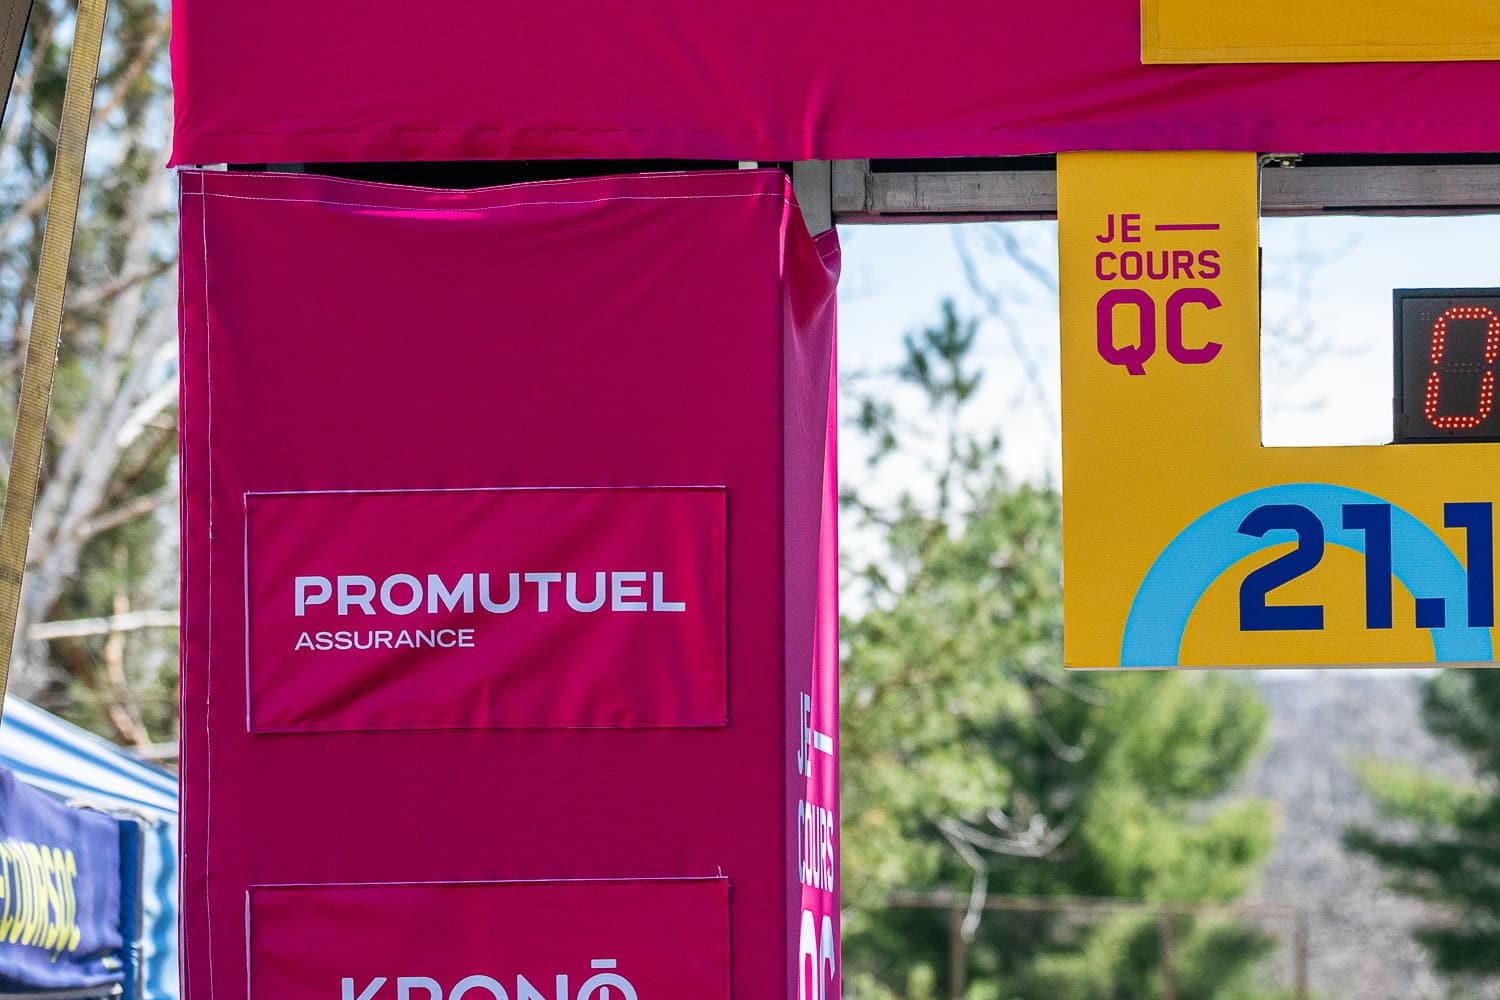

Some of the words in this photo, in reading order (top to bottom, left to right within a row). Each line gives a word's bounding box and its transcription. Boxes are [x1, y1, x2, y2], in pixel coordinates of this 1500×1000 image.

[1095, 213, 1142, 244] JE
[1095, 249, 1222, 281] COURS
[1095, 287, 1224, 376] QC
[294, 571, 687, 617] PROMUTUEL
[1236, 502, 1495, 632] 21.1
[294, 628, 476, 652] ASSURANCE
[797, 691, 812, 778] JE
[797, 799, 835, 894] COURS
